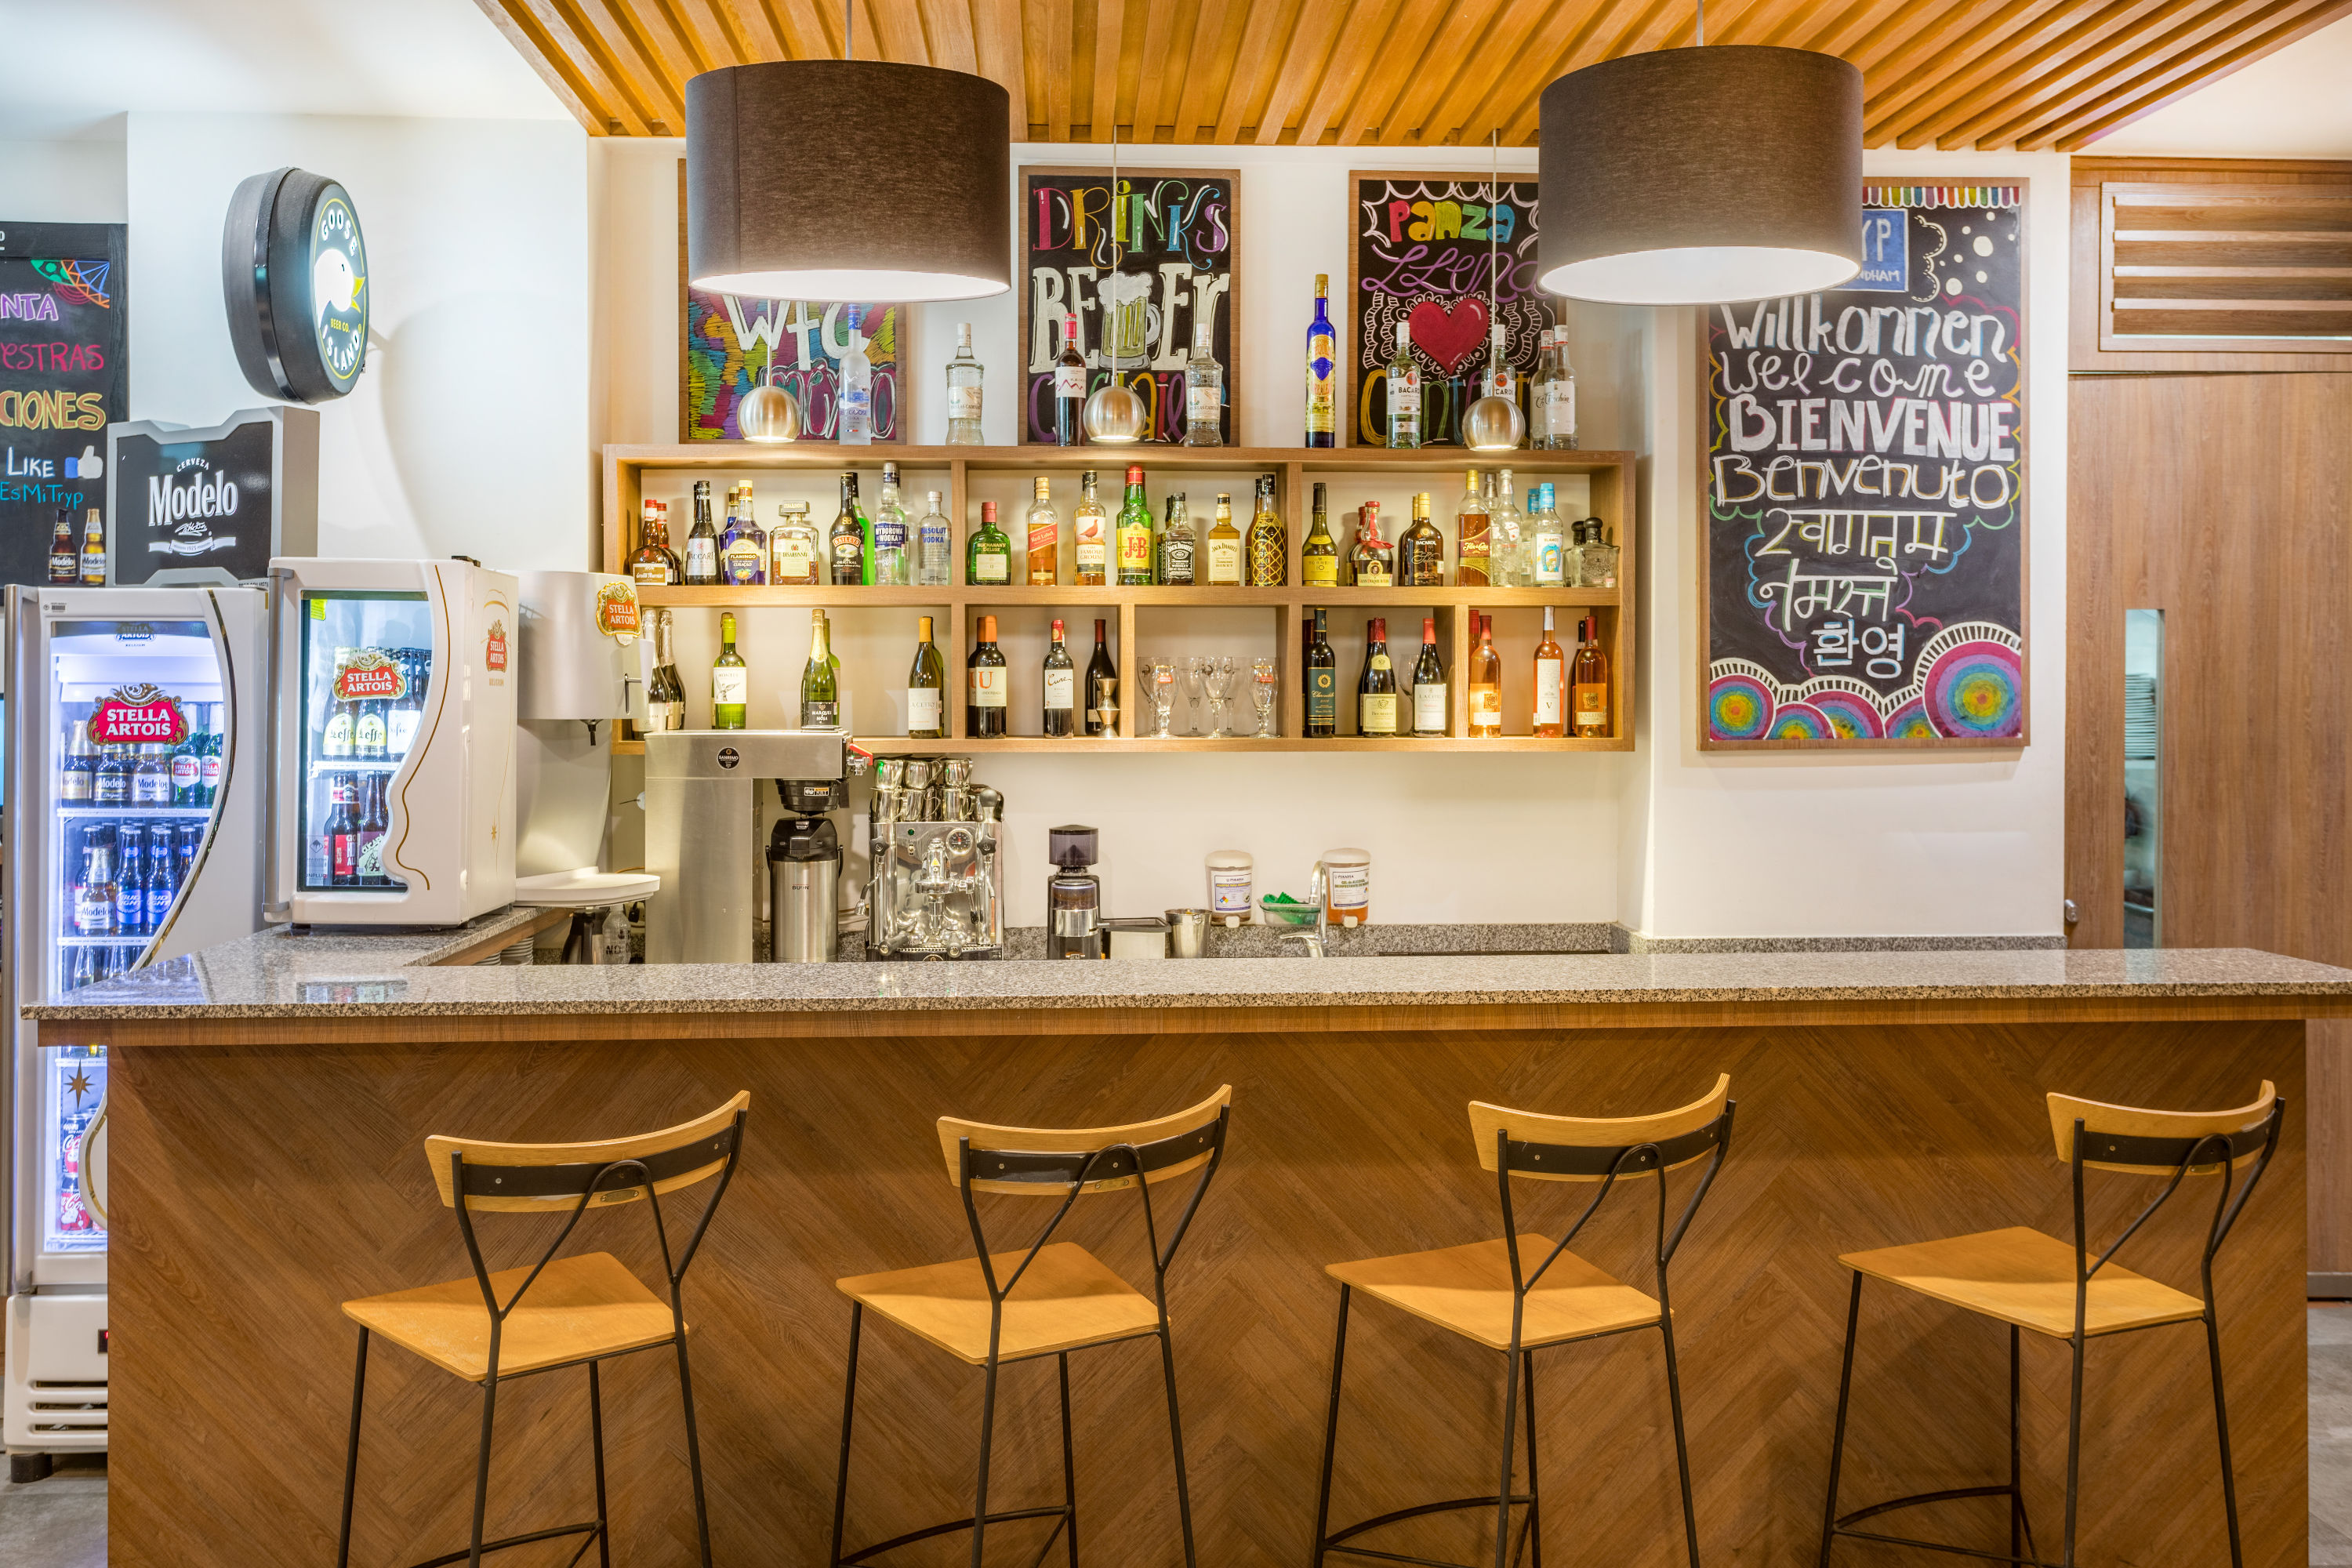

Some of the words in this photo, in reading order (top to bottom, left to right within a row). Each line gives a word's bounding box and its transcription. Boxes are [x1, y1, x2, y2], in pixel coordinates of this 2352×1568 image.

[321, 209, 358, 257] GOOSE
[330, 318, 342, 330] BEER
[321, 324, 360, 372] ISLAND
[1729, 393, 2015, 462] BIENVENUE
[176, 458, 209, 472] CERVEZA
[1714, 455, 2009, 510] Benvenuto
[148, 470, 238, 527] Modelo
[833, 535, 861, 547] BAILEYS
[1124, 536, 1147, 558] J&B
[52, 557, 74, 565] Modelo
[609, 604, 634, 615] STELLA
[610, 615, 636, 626] ARTOIS
[490, 641, 504, 652] STELLA
[1811, 619, 1905, 679] 환영
[489, 652, 504, 664] ARTOIS
[347, 672, 392, 683] STELLA
[978, 671, 993, 689] U
[347, 681, 393, 693] ARTOIS
[107, 709, 171, 722] STELLA
[106, 723, 172, 735] ARTOIS
[358, 728, 383, 741] Leffe
[97, 777, 126, 789] Modelo
[137, 779, 165, 789] Modelo
[82, 906, 110, 916] Modelo
